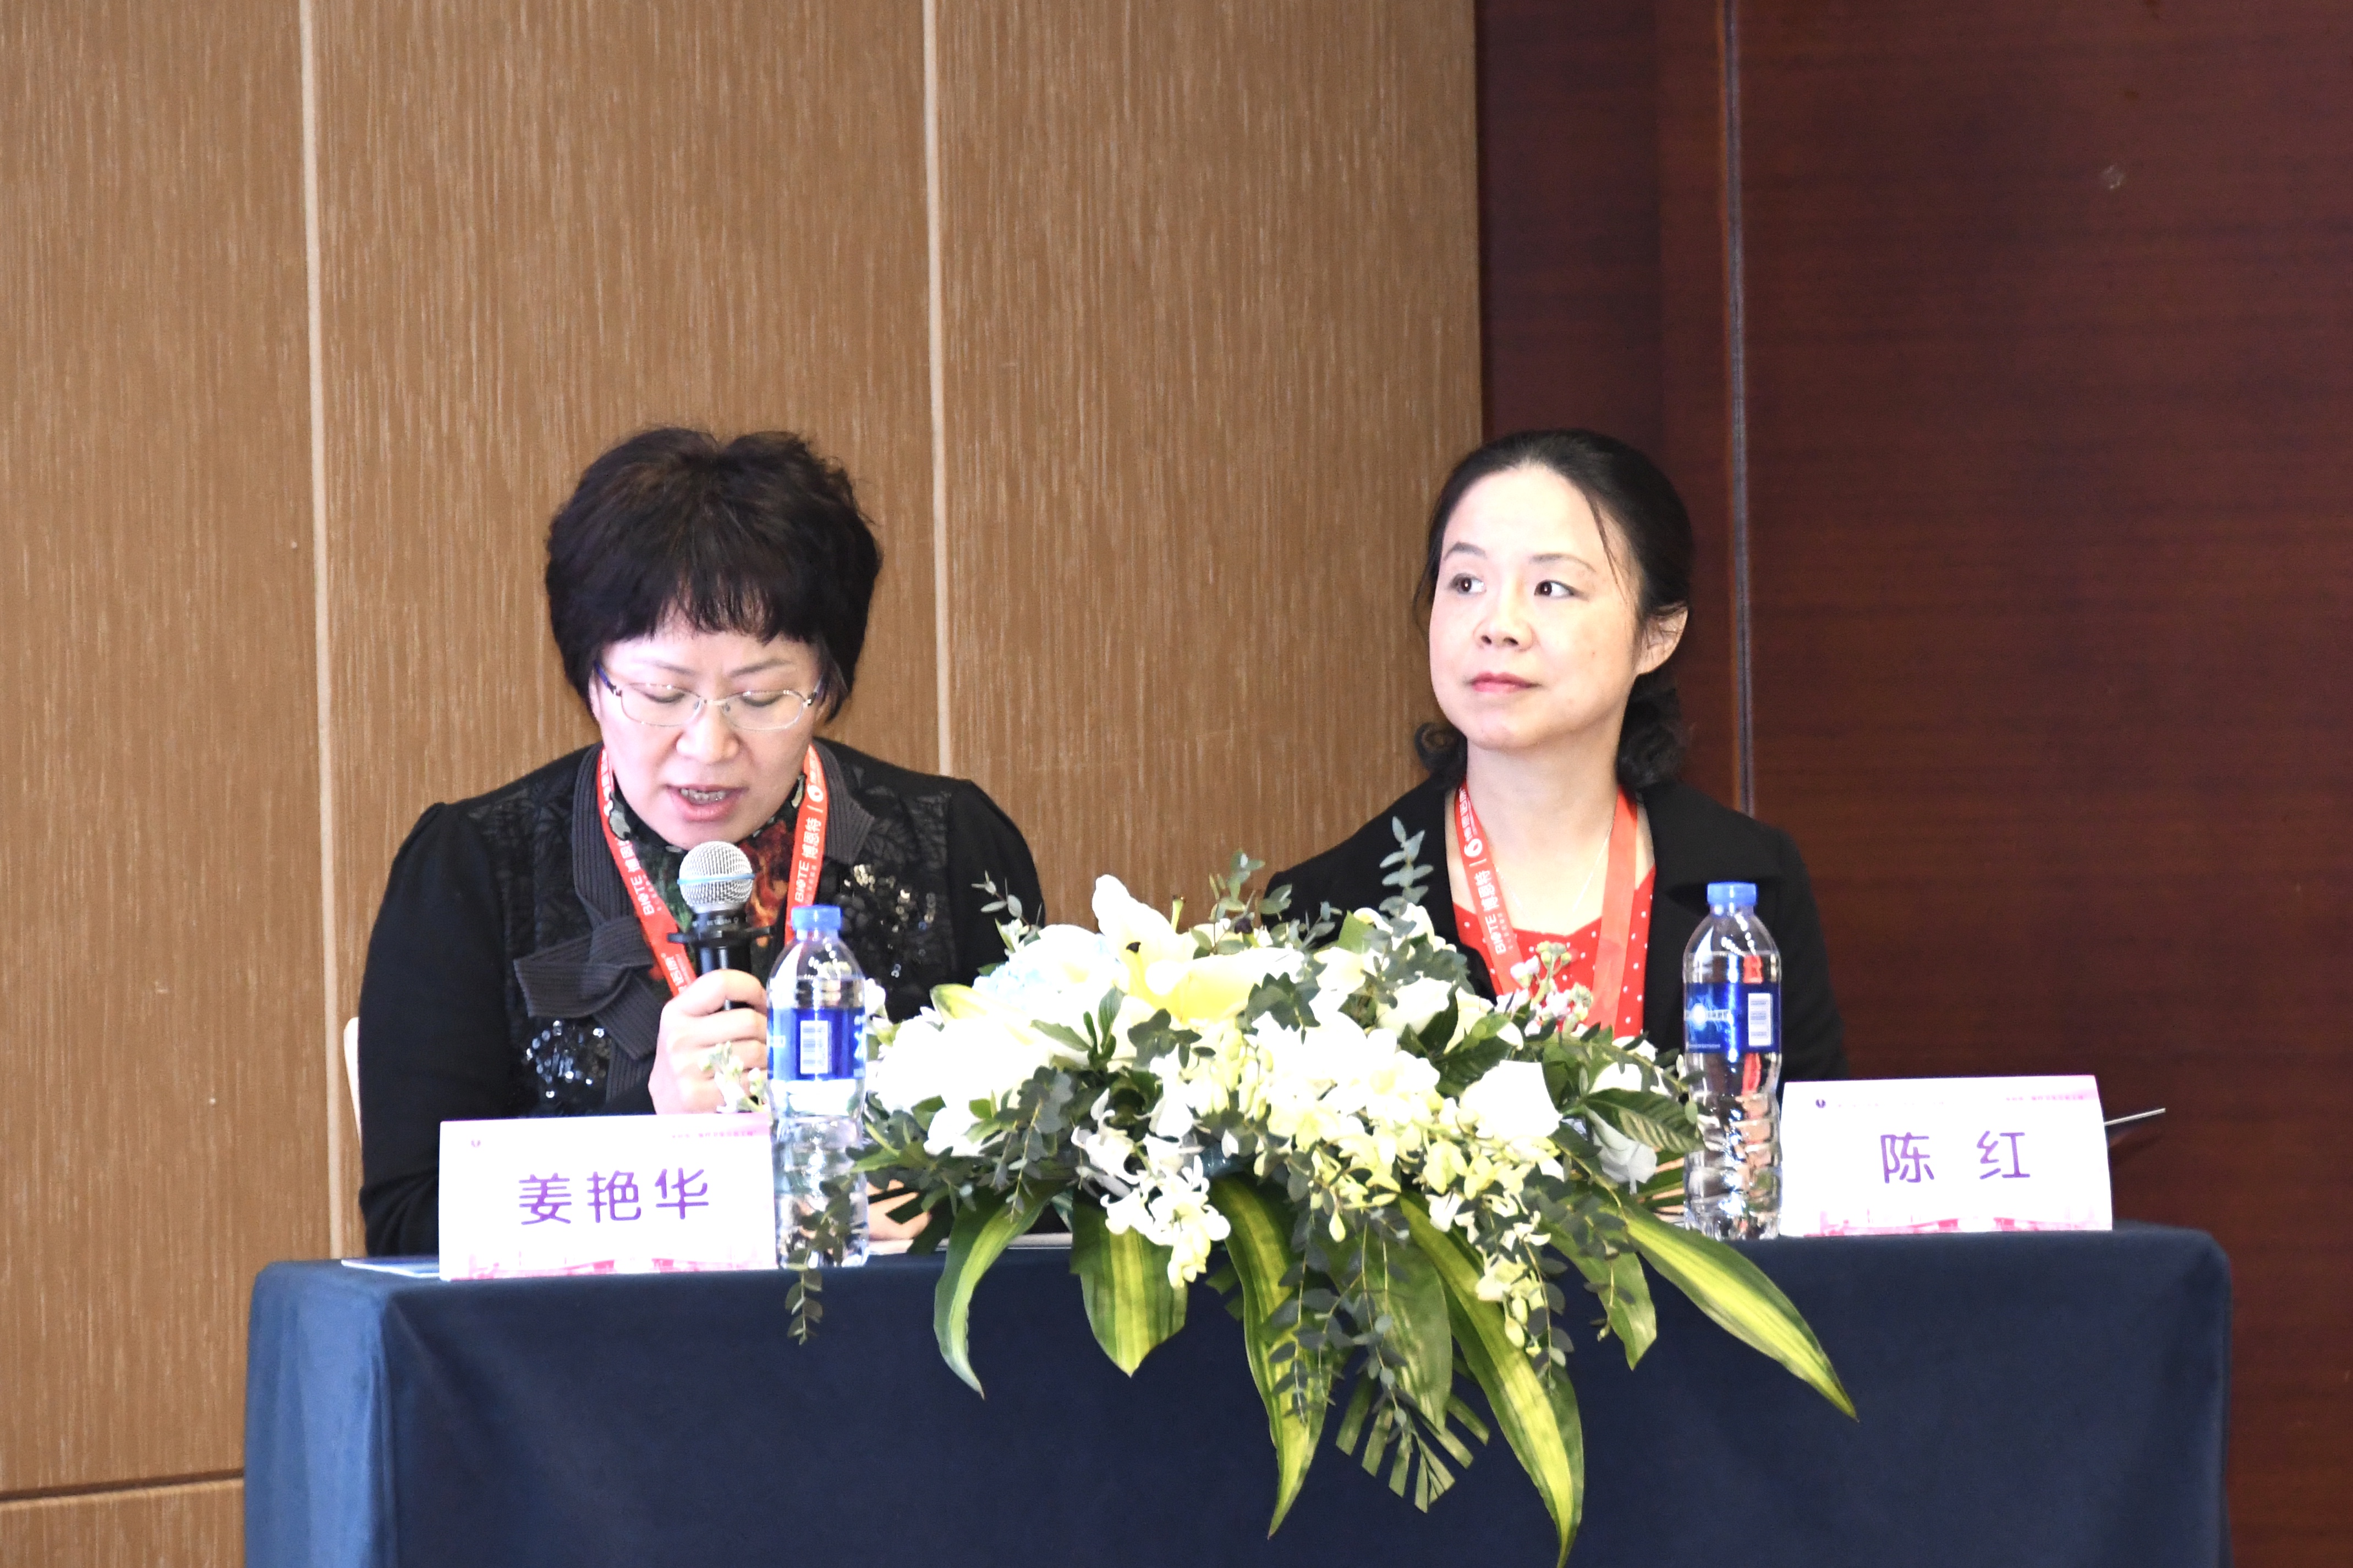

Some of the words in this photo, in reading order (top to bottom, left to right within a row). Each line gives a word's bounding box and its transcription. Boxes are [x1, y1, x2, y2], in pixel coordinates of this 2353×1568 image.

[802, 817, 822, 860] 博恩特
[1474, 870, 1500, 912] 博恩特
[519, 1168, 709, 1225] 姜艳华
